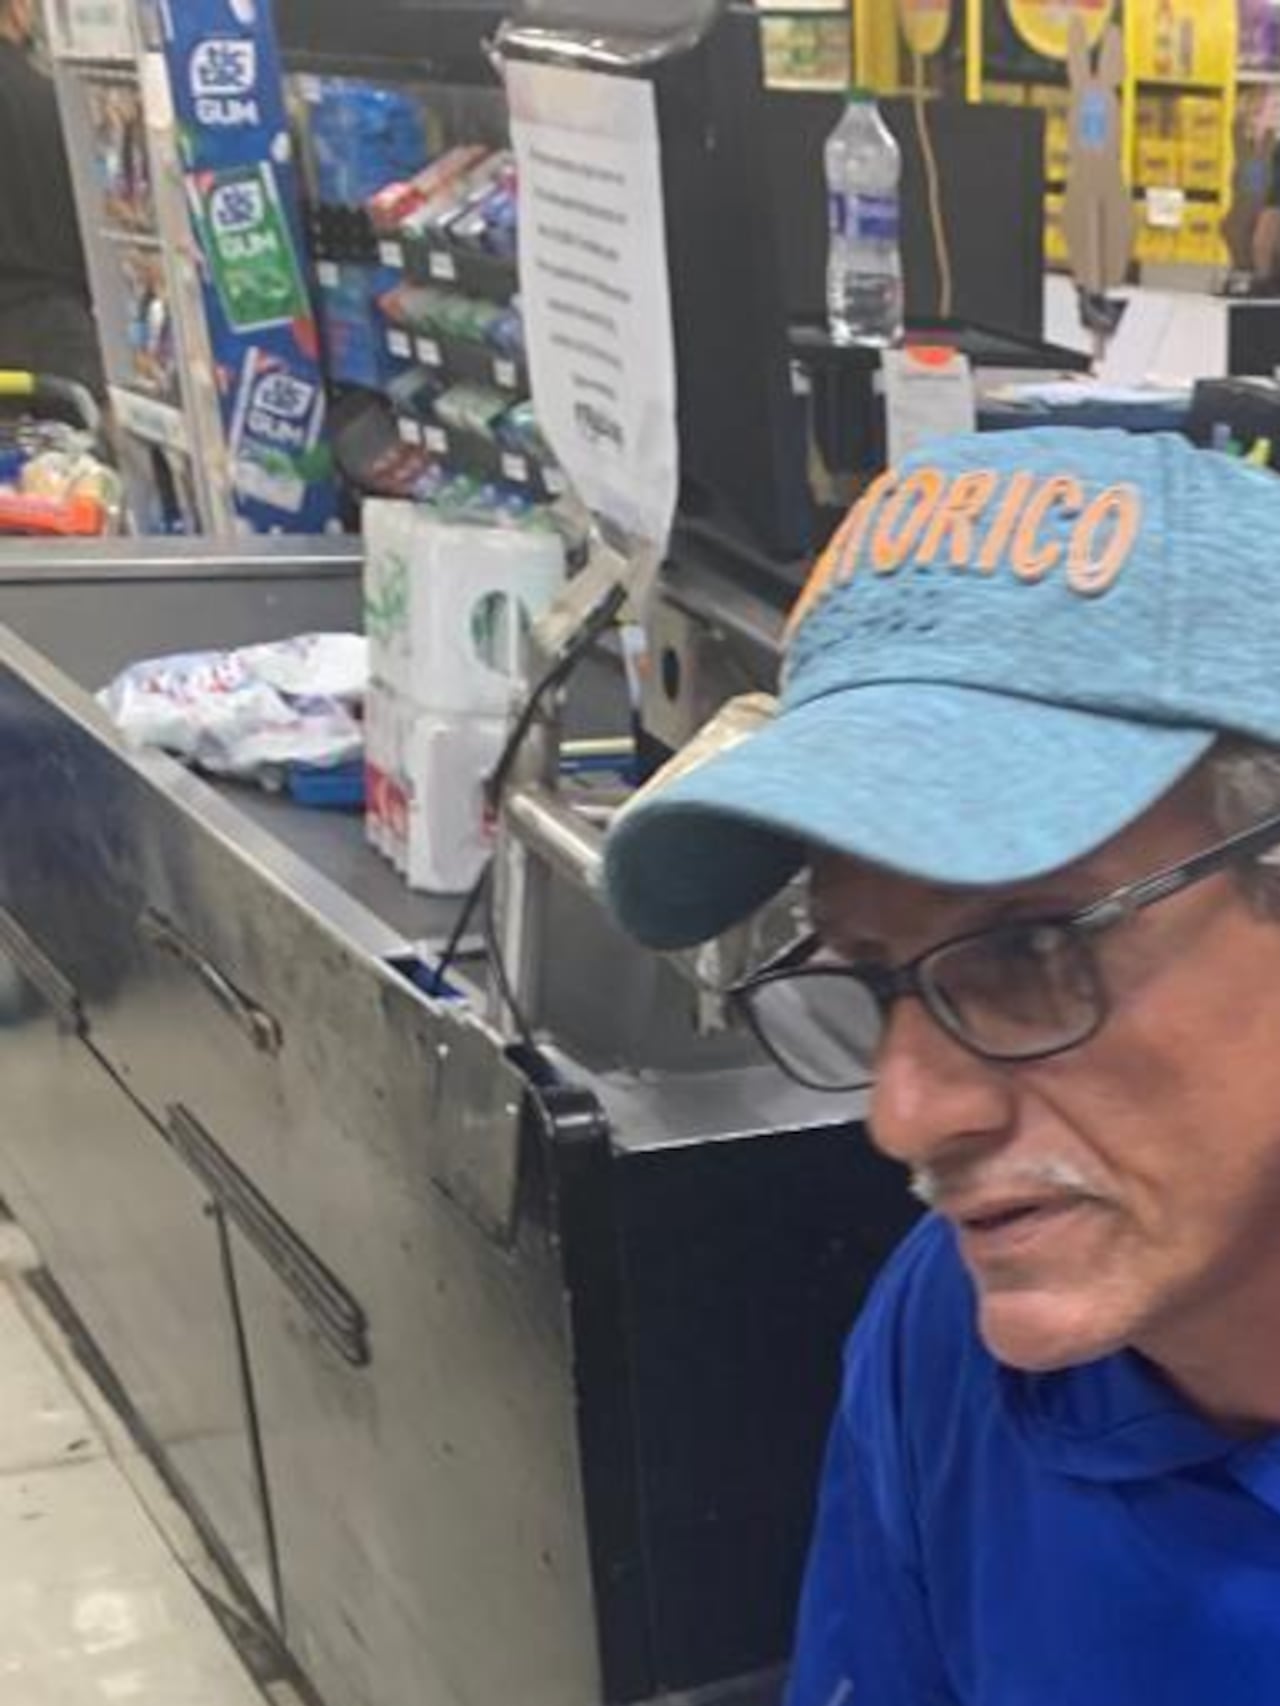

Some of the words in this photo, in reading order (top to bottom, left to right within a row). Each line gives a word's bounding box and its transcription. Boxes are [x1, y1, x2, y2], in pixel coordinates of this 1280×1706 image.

[196, 98, 260, 126] GUM
[219, 229, 278, 260] GUM
[247, 409, 304, 443] GUM
[805, 465, 1139, 612] TORICO
